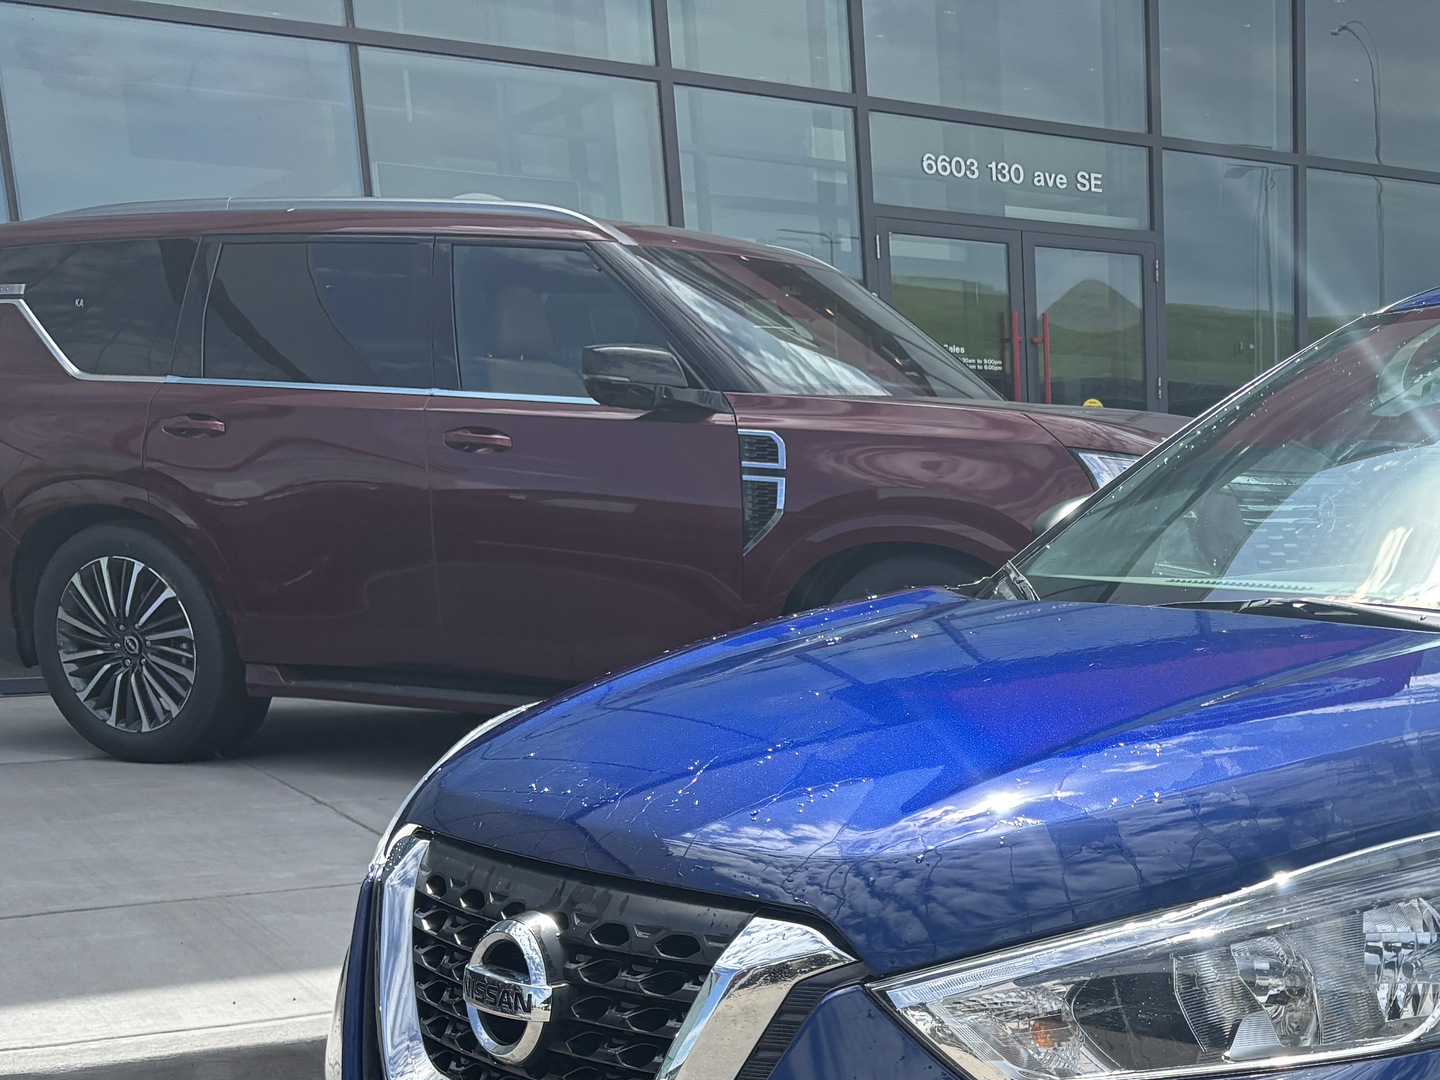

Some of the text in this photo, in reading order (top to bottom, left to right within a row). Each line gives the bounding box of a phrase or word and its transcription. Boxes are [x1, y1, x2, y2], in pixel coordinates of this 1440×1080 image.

[922, 153, 1102, 192] 6603 130 ave SE
